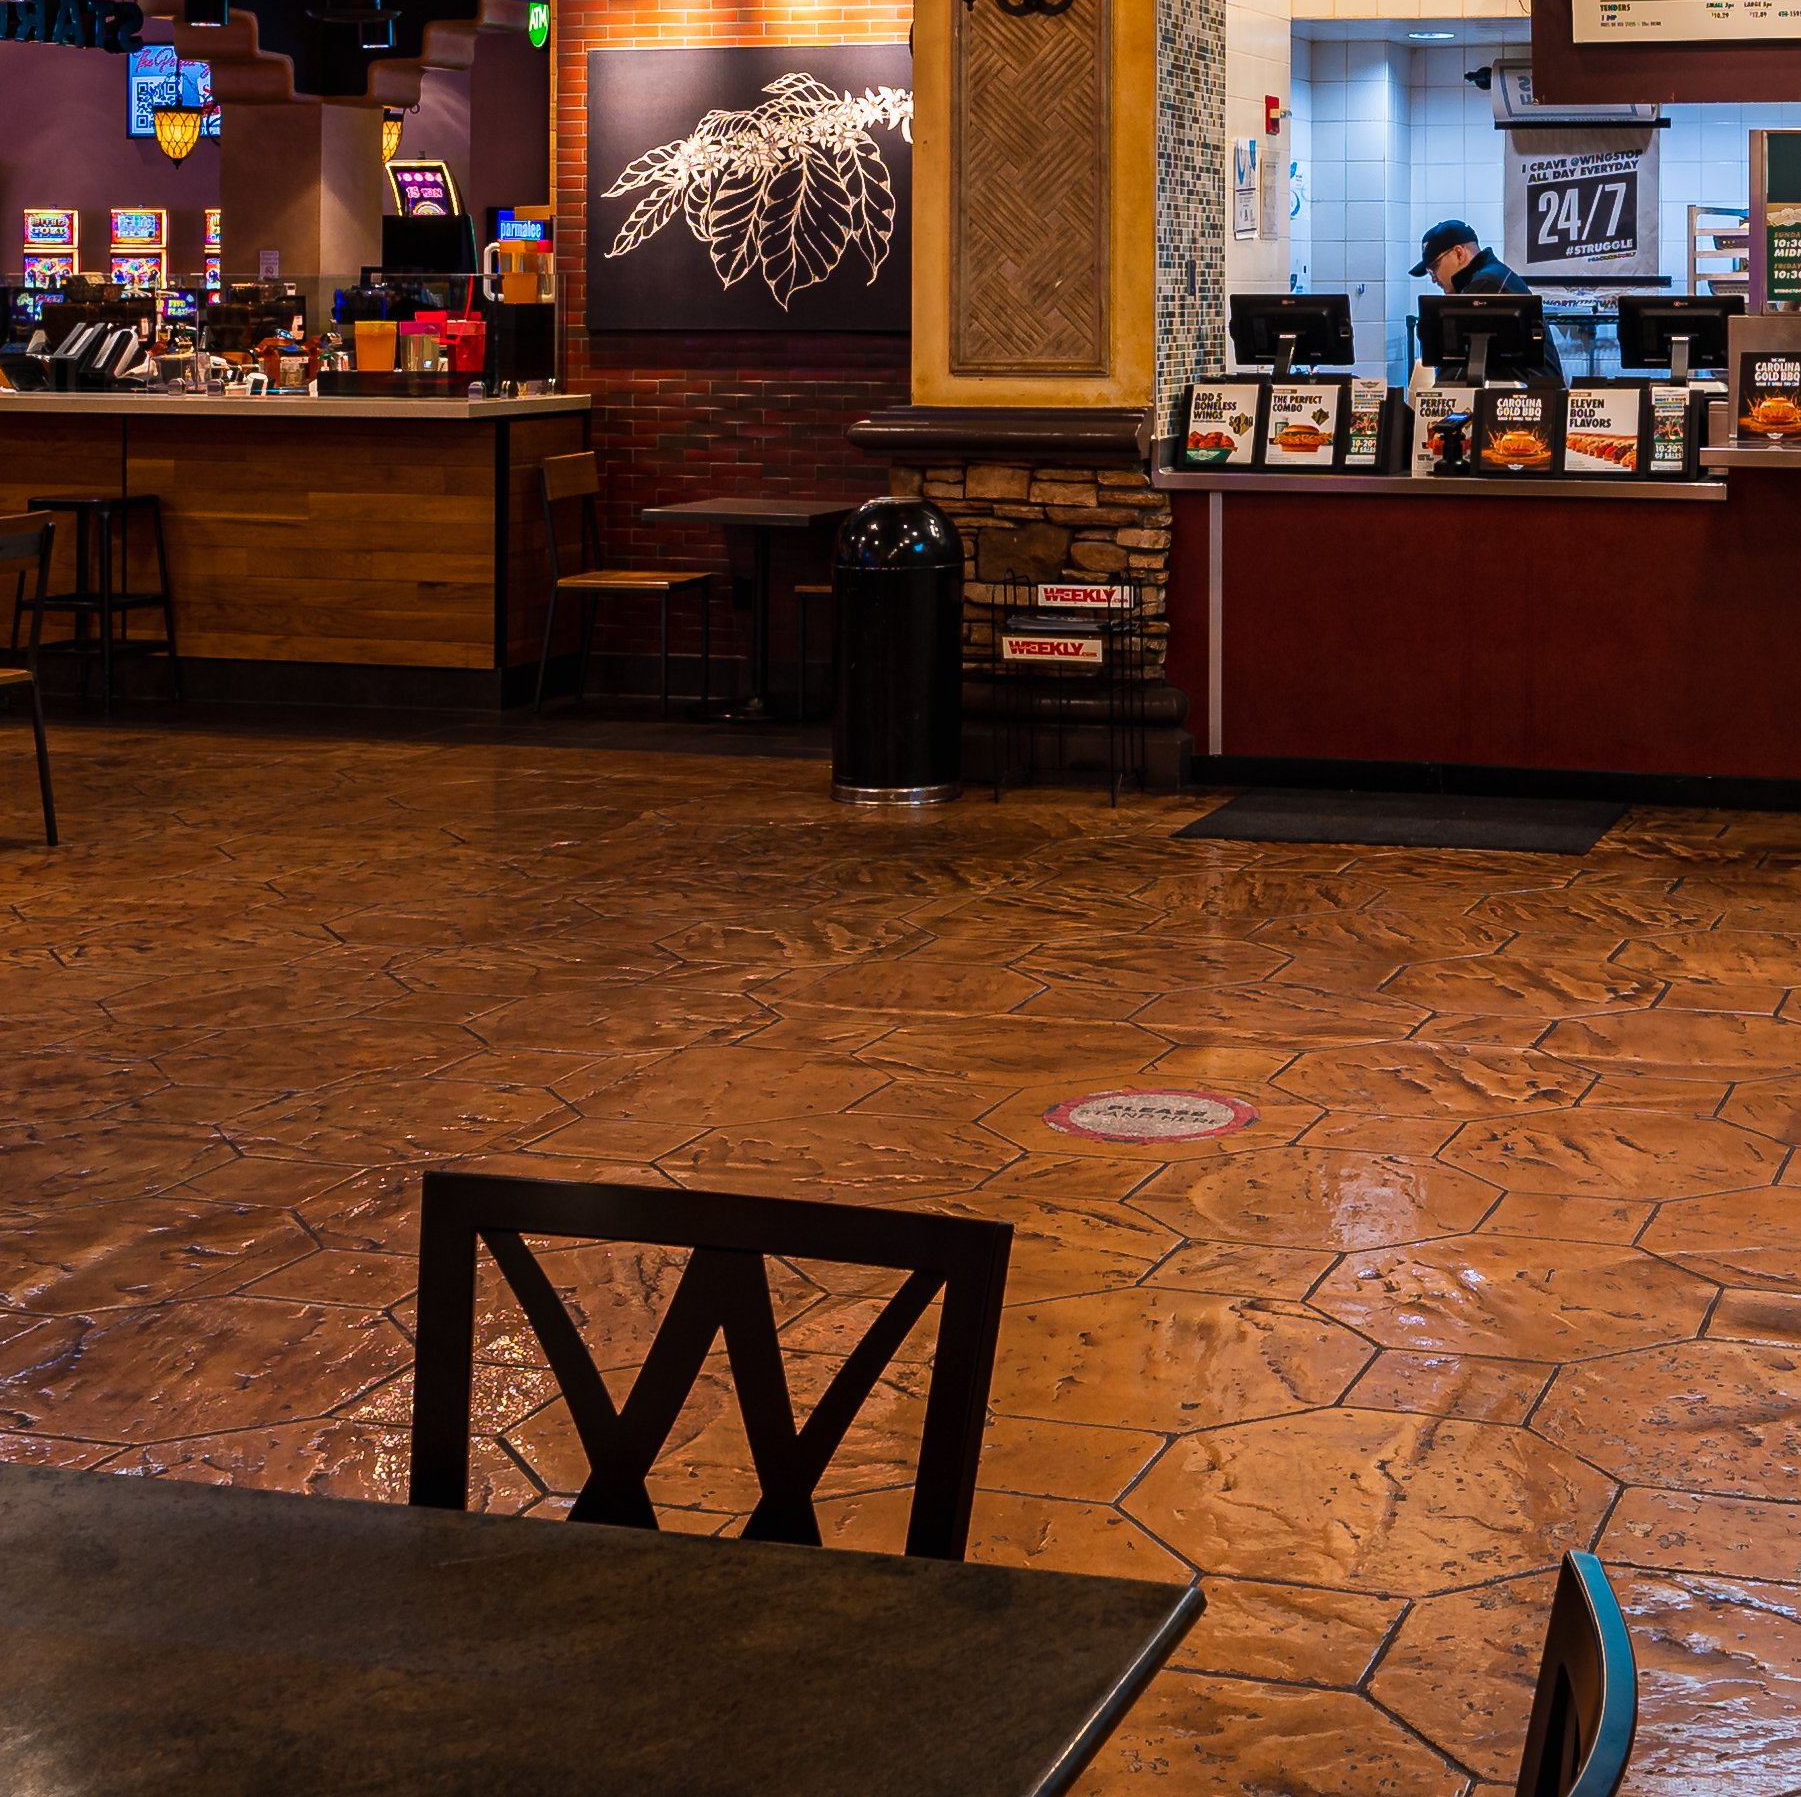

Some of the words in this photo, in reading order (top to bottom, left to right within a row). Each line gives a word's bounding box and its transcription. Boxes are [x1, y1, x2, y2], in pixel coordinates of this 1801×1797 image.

[529, 6, 549, 31] ATM
[1521, 164, 1526, 173] I
[1530, 158, 1567, 172] CRAVE
[1570, 149, 1643, 167] @WINGSTOP
[1528, 170, 1549, 183] ALL
[1553, 168, 1576, 180] DAY
[1580, 160, 1639, 176] EVERYDAY
[1538, 182, 1626, 245] 24/7
[500, 221, 542, 240] parmalee
[1566, 238, 1633, 256] #STRUGGLE
[1755, 362, 1801, 372] CAROLINA
[1754, 371, 1779, 381] GOLD
[1780, 371, 1801, 382] BBQ
[1194, 392, 1214, 402] ADD
[1216, 392, 1223, 402] 5
[1272, 395, 1288, 405] THE
[1289, 395, 1323, 405] PERFECT
[1193, 401, 1237, 411] BONELESS
[1420, 398, 1457, 408] PERFECT
[1496, 398, 1542, 408] CAROLINA
[1570, 398, 1605, 409] ELEVEN
[1272, 404, 1303, 413] COMBO
[1419, 407, 1454, 417] COMBO
[1496, 407, 1521, 417] GOLD
[1522, 407, 1542, 418] BBQ
[1569, 408, 1596, 418] BOLD
[1193, 411, 1223, 420] WINGS
[1569, 418, 1612, 428] FLAVORS
